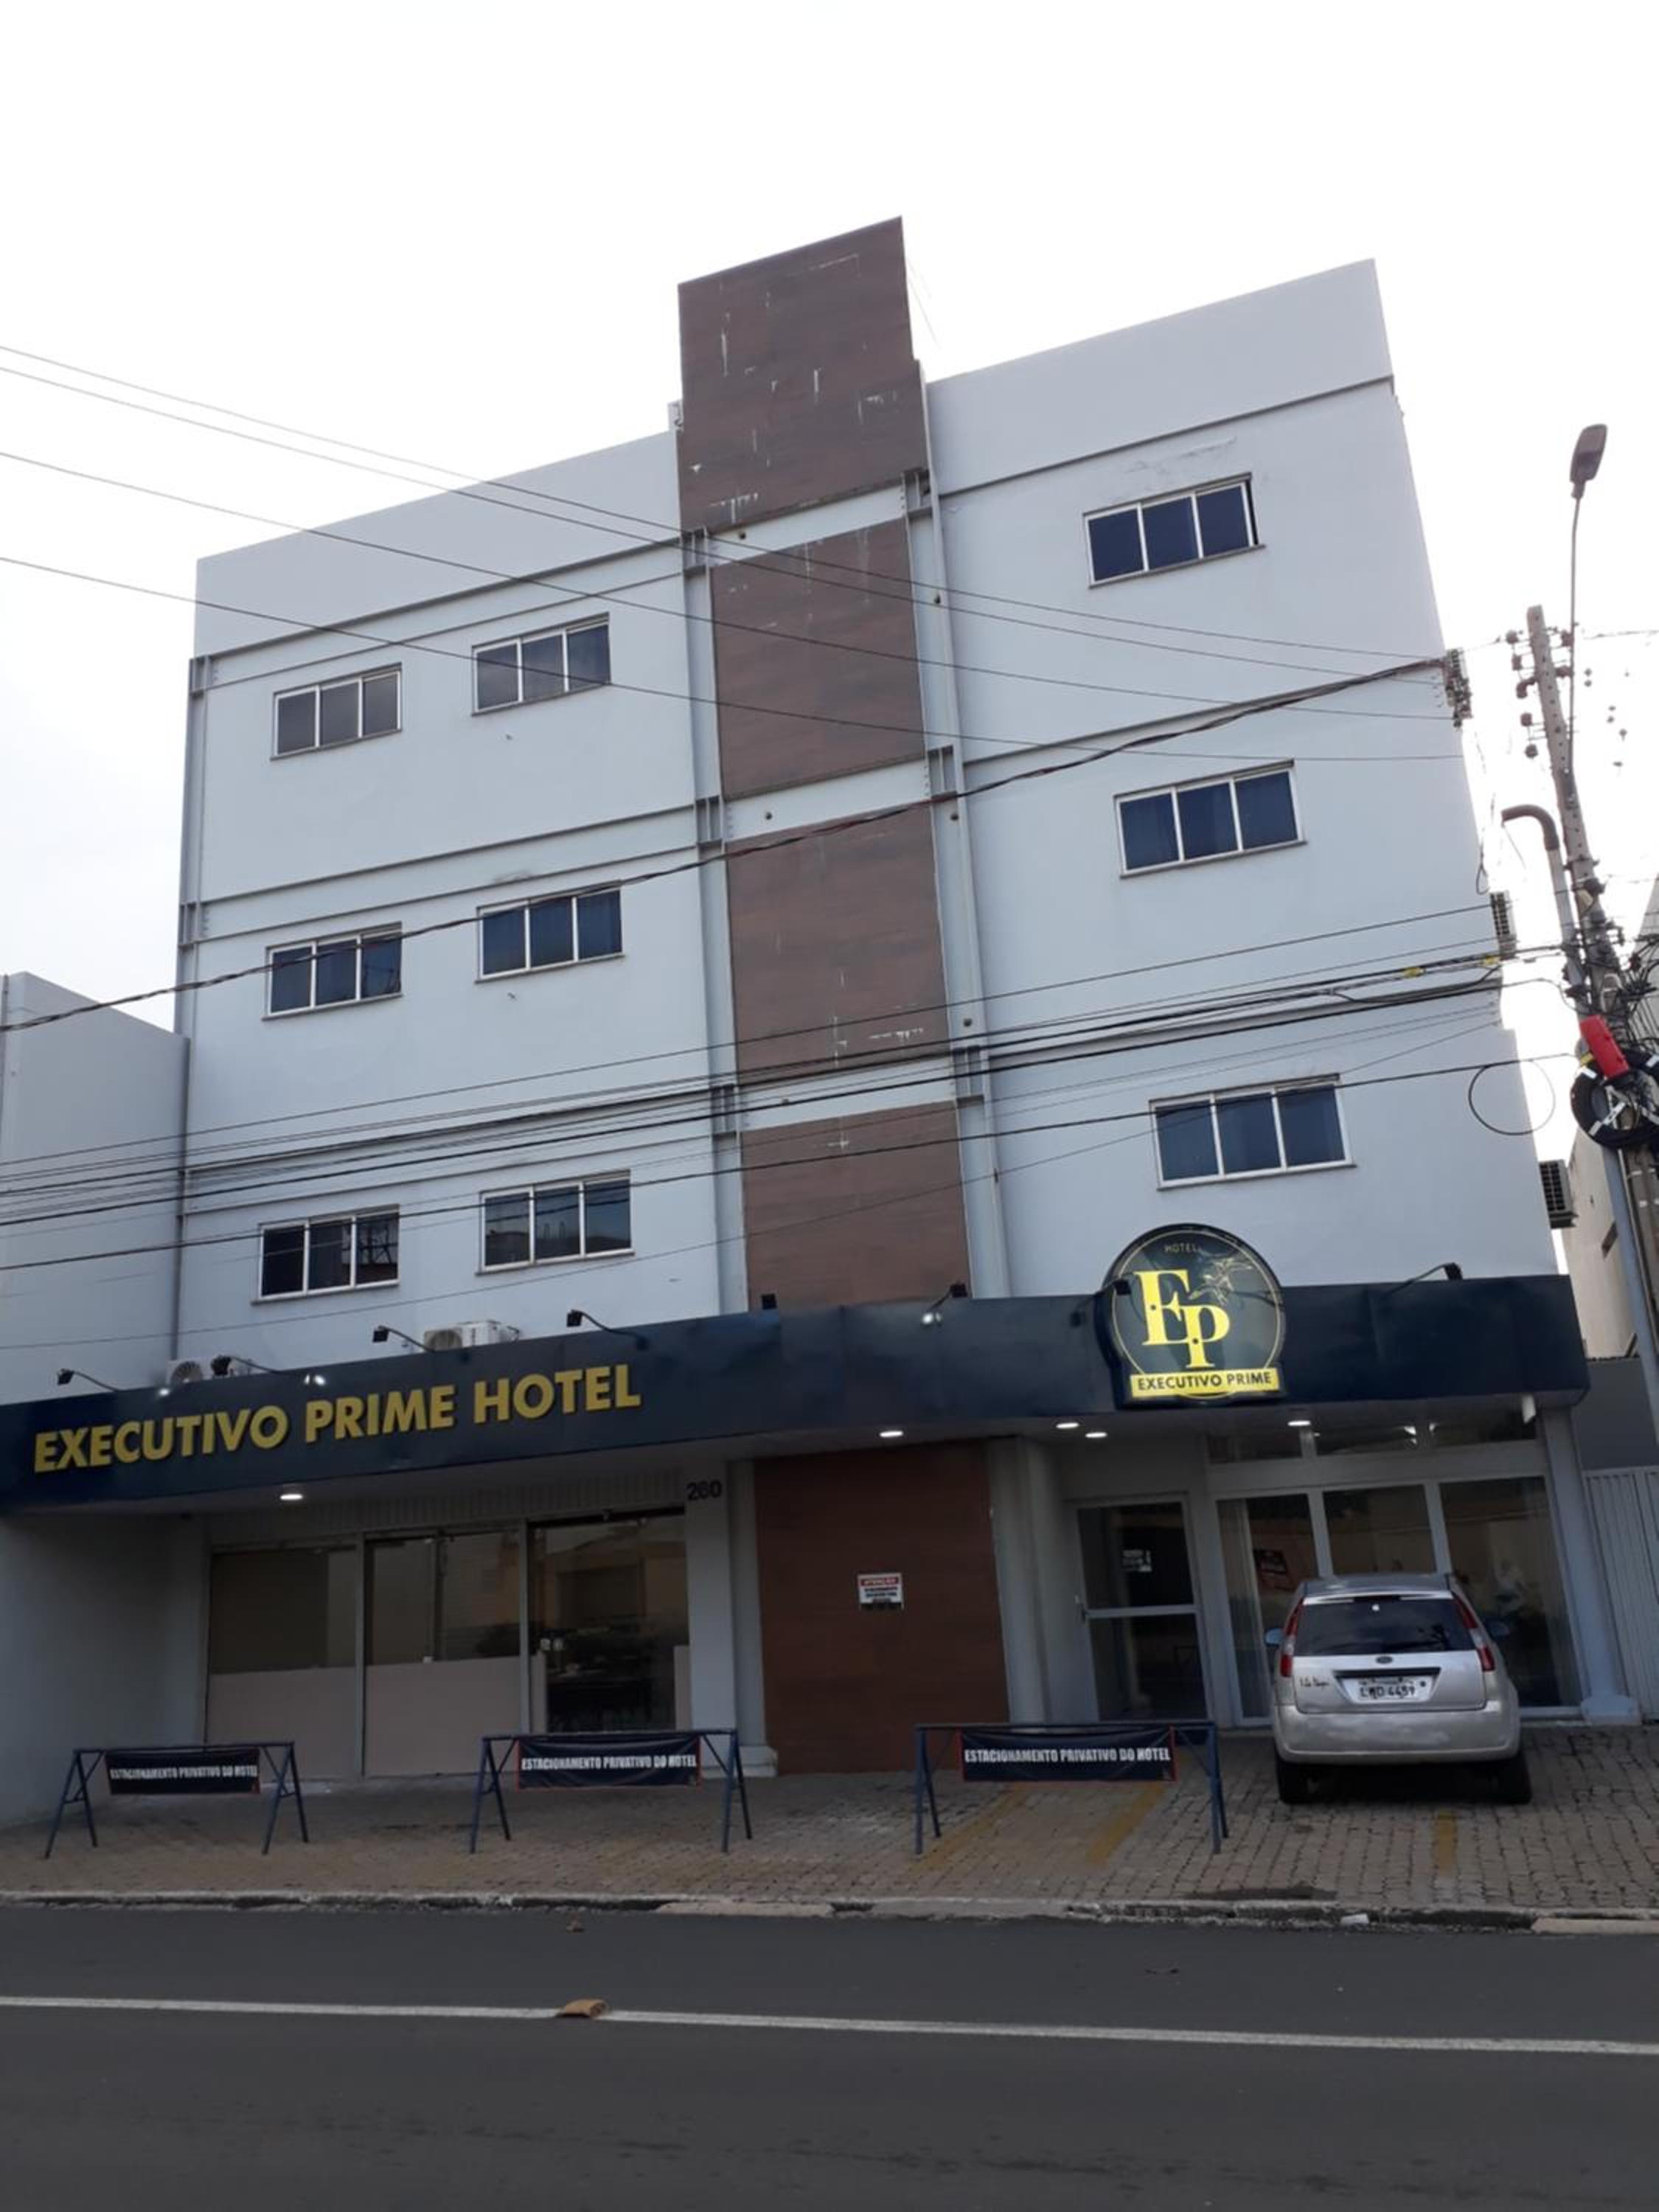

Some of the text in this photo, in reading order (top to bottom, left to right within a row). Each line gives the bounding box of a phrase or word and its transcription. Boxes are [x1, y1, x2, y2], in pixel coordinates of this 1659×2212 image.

[1164, 1242, 1196, 1253] HOTEL
[1138, 1371, 1272, 1390] EXECUTIVO PRIME
[34, 1365, 641, 1472] EXECUTIVO PRIME HOTEL
[521, 1754, 696, 1770] ESTACIONAMENTO PRIVATIVO DO HOTEL
[964, 1747, 1170, 1763] ESTACIONAMENTO PRIVATIVO DO HOTEL
